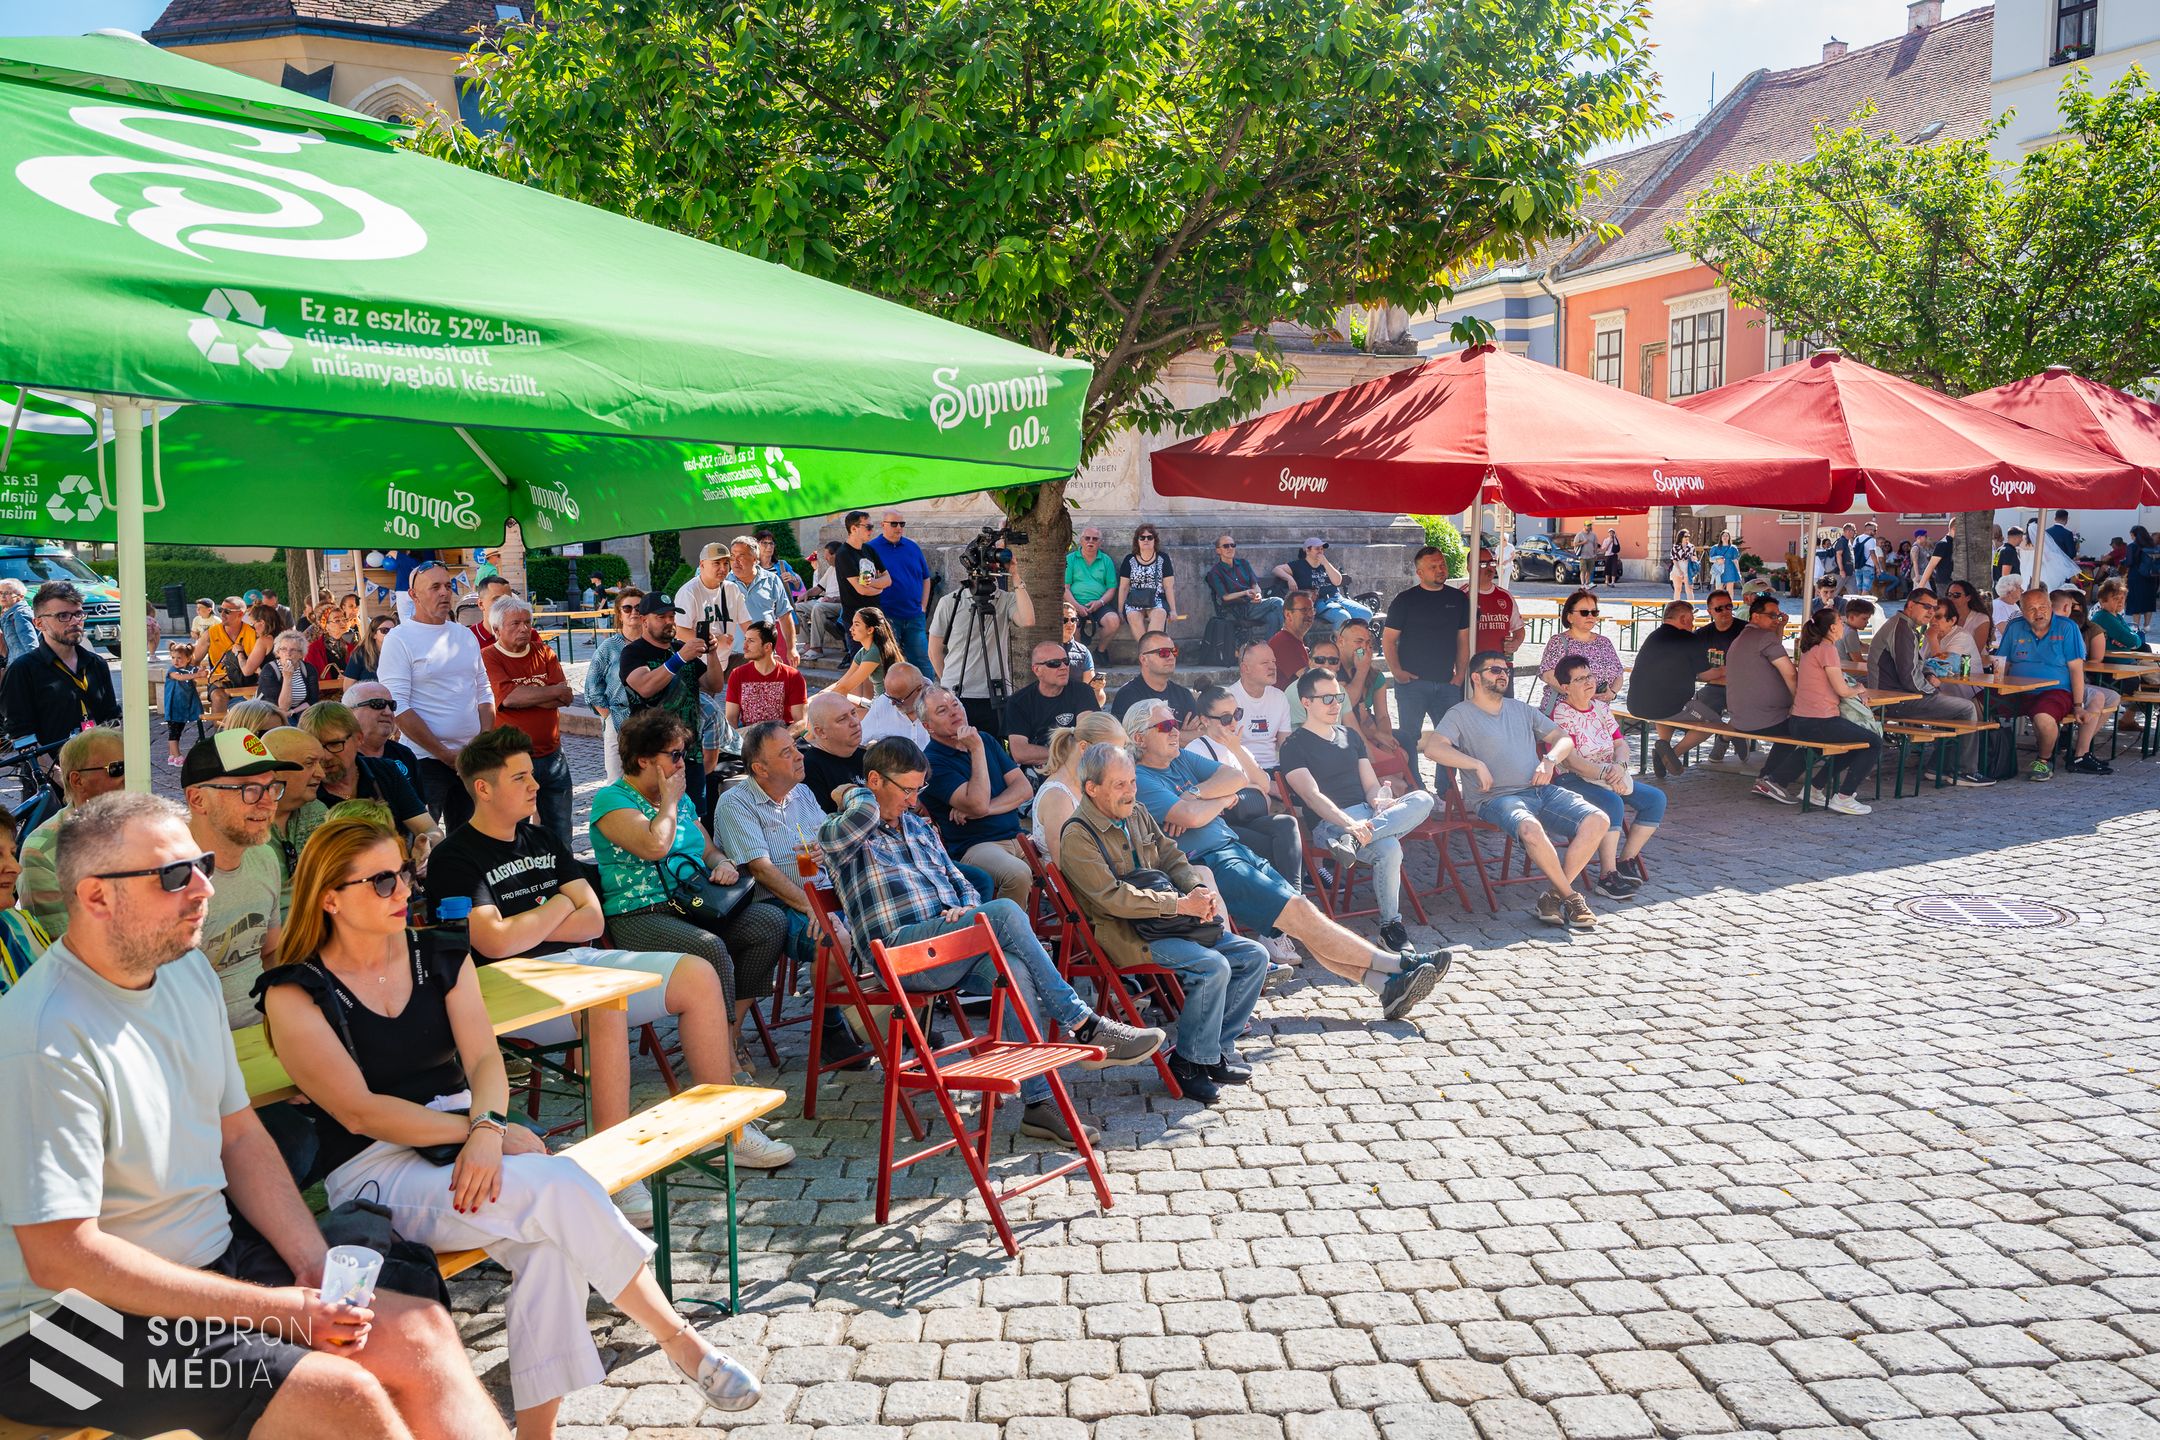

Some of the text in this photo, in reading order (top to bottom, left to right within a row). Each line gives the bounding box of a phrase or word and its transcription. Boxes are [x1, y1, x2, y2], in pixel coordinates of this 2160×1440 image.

[301, 297, 542, 347] Ez az eszköz 52%-ban
[305, 328, 493, 367] újrahasznosított
[311, 353, 547, 398] műanyagból készült.
[929, 366, 1048, 435] Soproni
[1278, 467, 1329, 499] Sopron
[1652, 469, 1705, 499] Sopron
[1989, 474, 2037, 502] Sopron
[1478, 622, 1506, 630] FLY BETTER
[1479, 613, 1510, 623] mirates
[501, 892, 515, 901] PRO
[530, 885, 539, 893] ET
